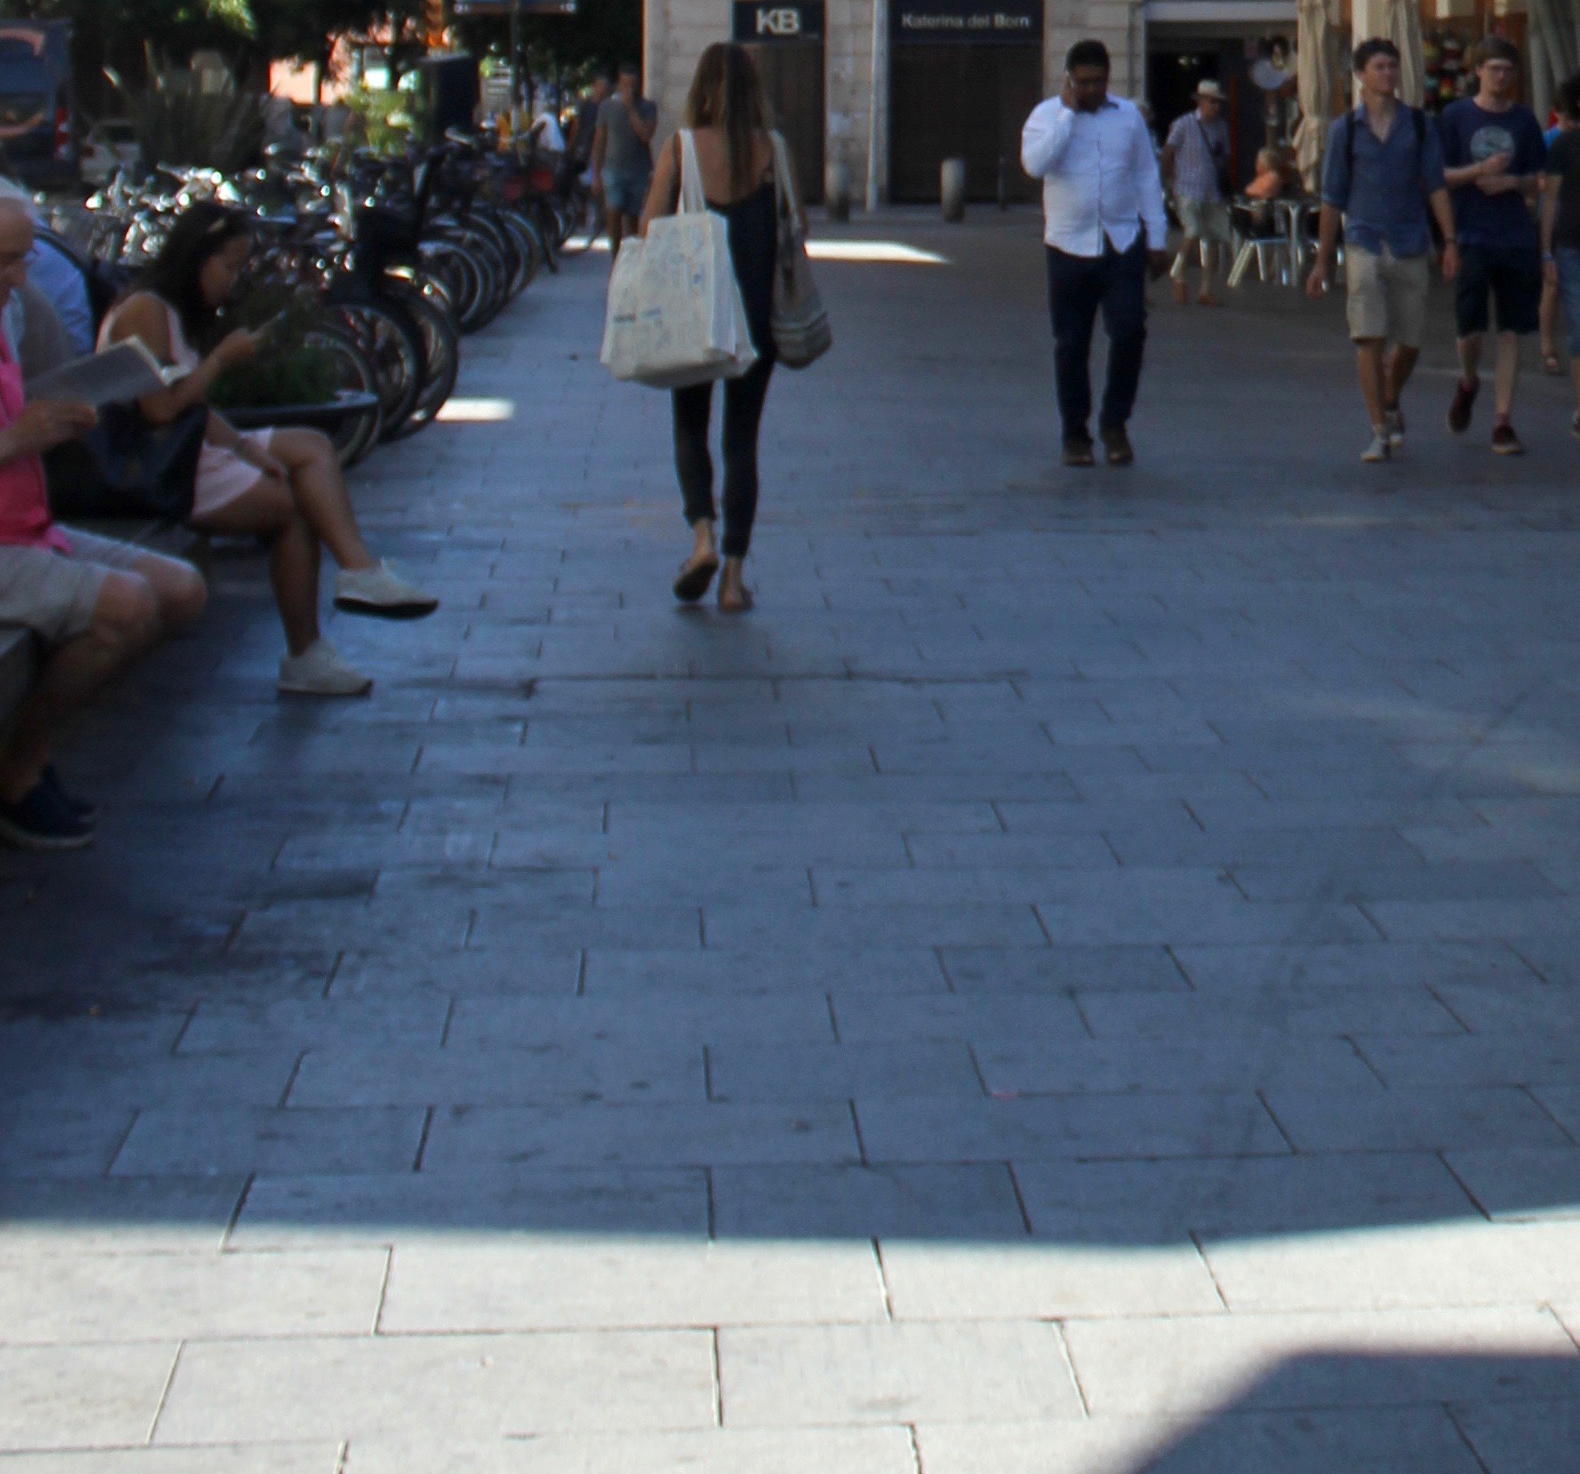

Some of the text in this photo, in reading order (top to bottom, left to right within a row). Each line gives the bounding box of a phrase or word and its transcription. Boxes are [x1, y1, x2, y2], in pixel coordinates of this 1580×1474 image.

[756, 8, 800, 35] KB
[902, 12, 1030, 30] Katerina del Born
